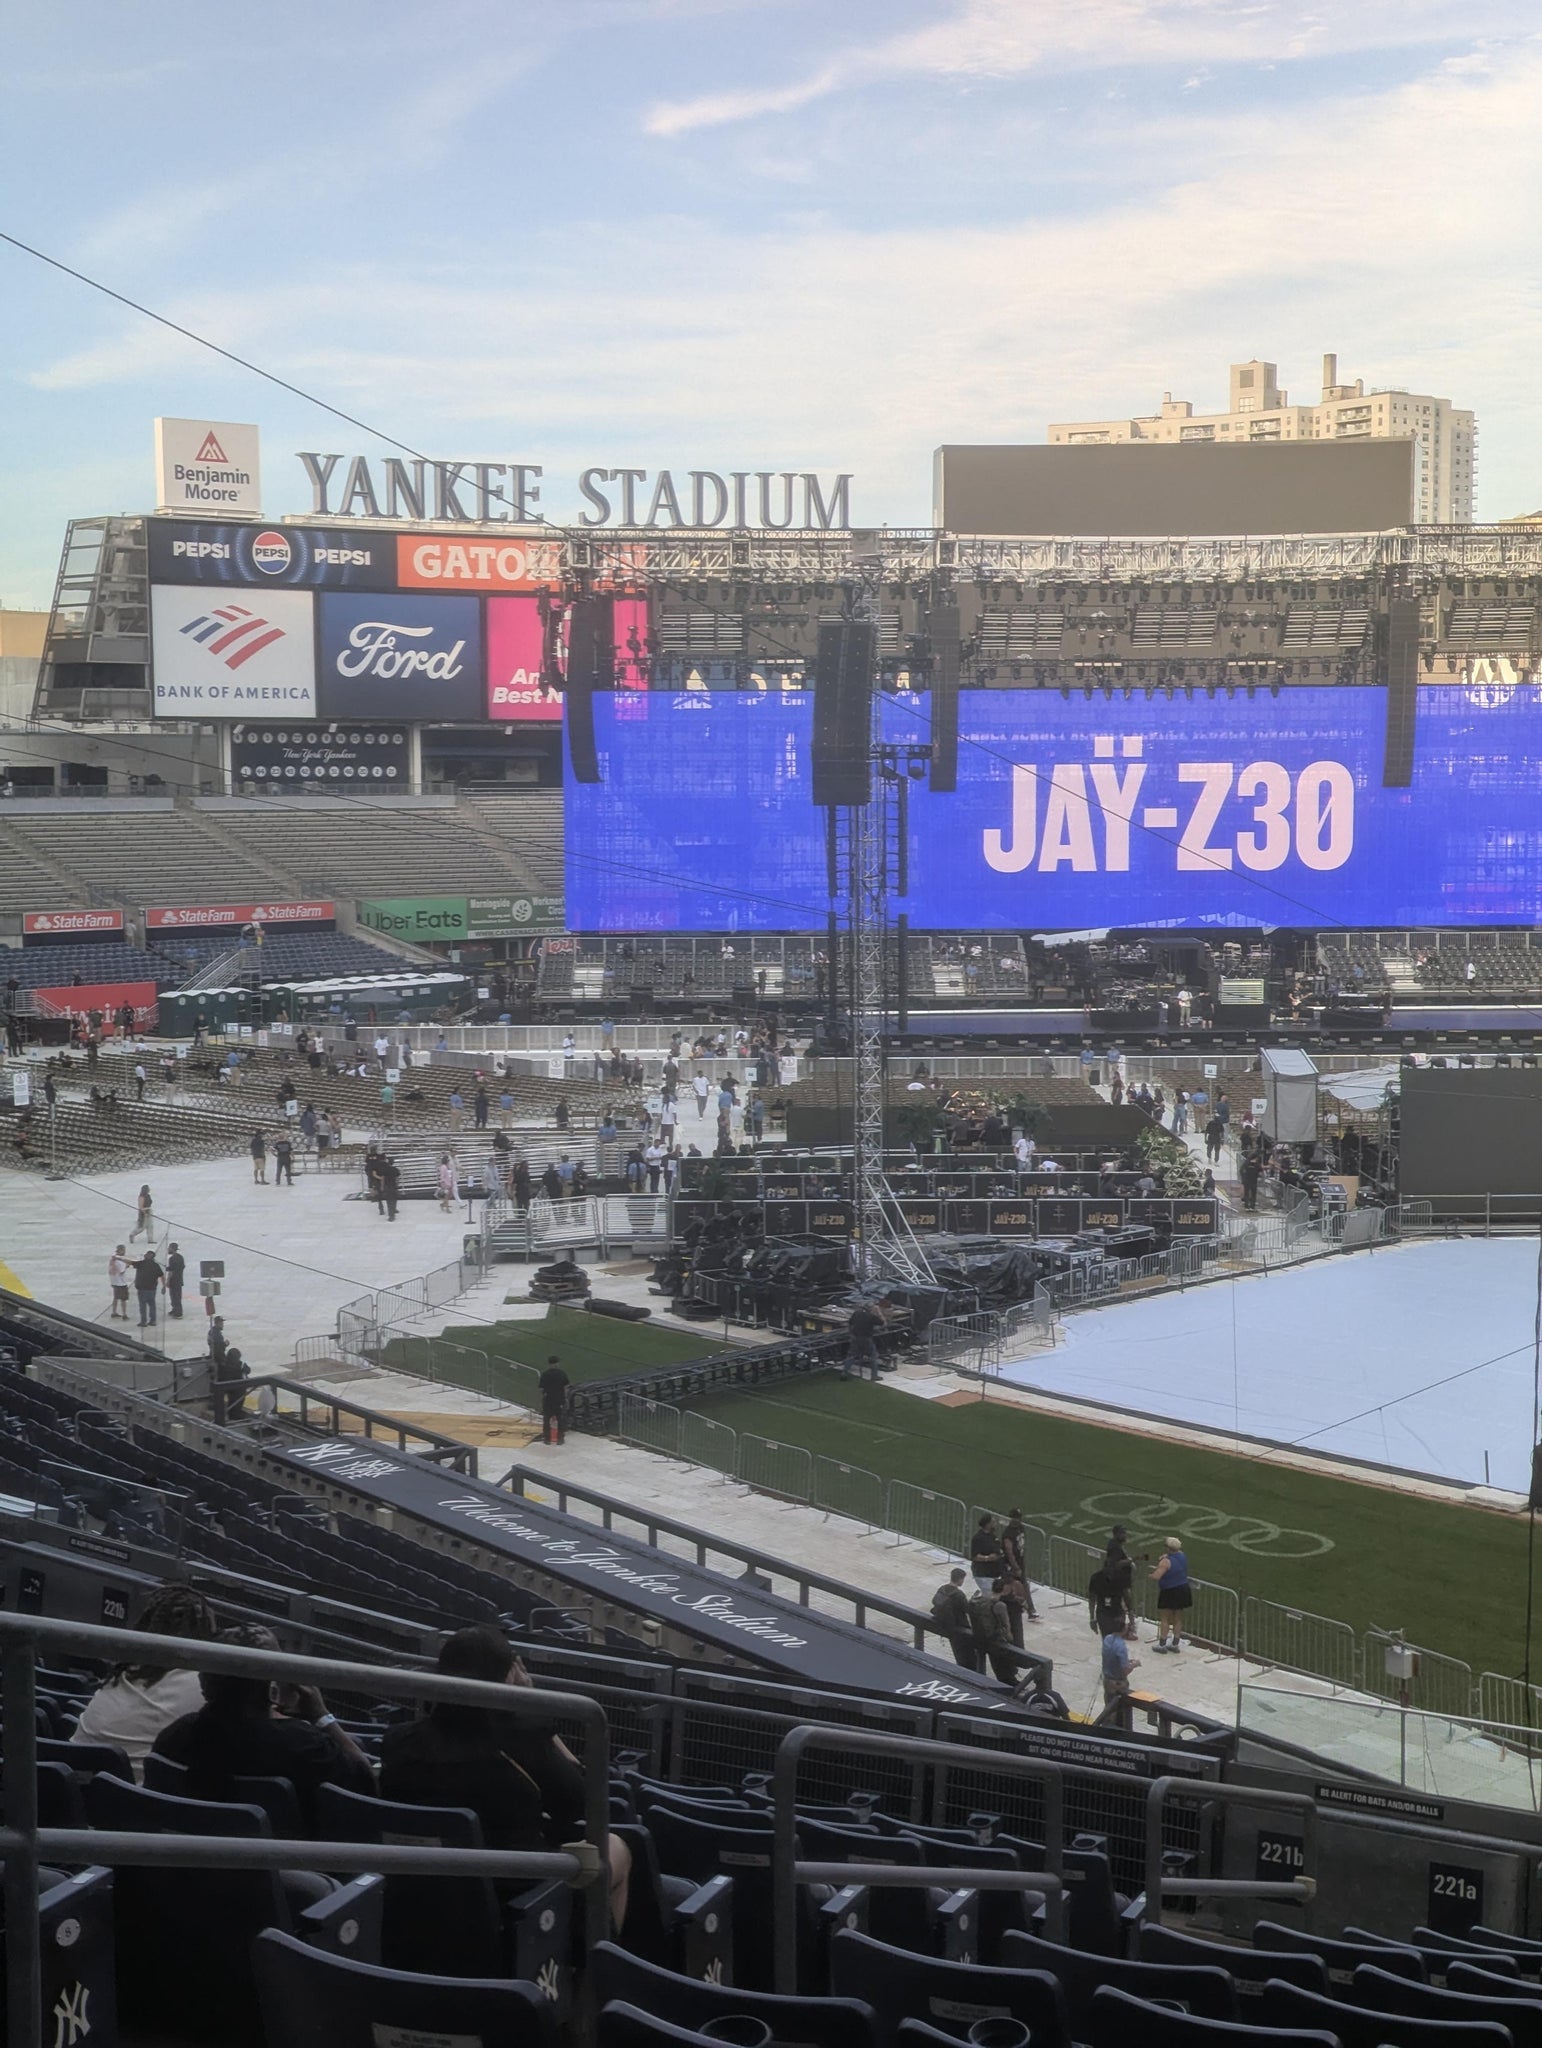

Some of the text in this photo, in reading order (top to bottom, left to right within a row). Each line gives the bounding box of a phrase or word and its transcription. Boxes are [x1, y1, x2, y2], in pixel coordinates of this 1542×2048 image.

[174, 464, 250, 486] Benjamin
[185, 483, 238, 501] Moore
[296, 452, 855, 530] YANKEE STADIUM
[173, 541, 230, 559] PEPSI
[255, 548, 288, 558] PEPSI
[314, 548, 371, 566] PEPSI
[336, 621, 466, 680] Ford
[156, 685, 310, 700] BANK OF AMERICA
[492, 687, 542, 704] Best
[416, 910, 462, 928] Eats
[437, 1495, 807, 1649] Welcome to Yankee Stadium
[1020, 1732, 1045, 1744] PLEASE
[1046, 1736, 1056, 1746] DO
[1057, 1738, 1071, 1748] NOT
[1072, 1740, 1089, 1751] LEAN
[1103, 1746, 1126, 1758] REACH
[1029, 1745, 1039, 1753] SIT
[1040, 1746, 1050, 1755] ON
[1051, 1748, 1061, 1757] OR
[1062, 1751, 1084, 1761] STAND
[1085, 1754, 1104, 1765] NEAR
[1320, 1788, 1439, 1816] BE ALERT FOR BATS AND/OR BALLS
[1260, 1841, 1304, 1867] 221b
[1433, 1873, 1477, 1900] 221a
